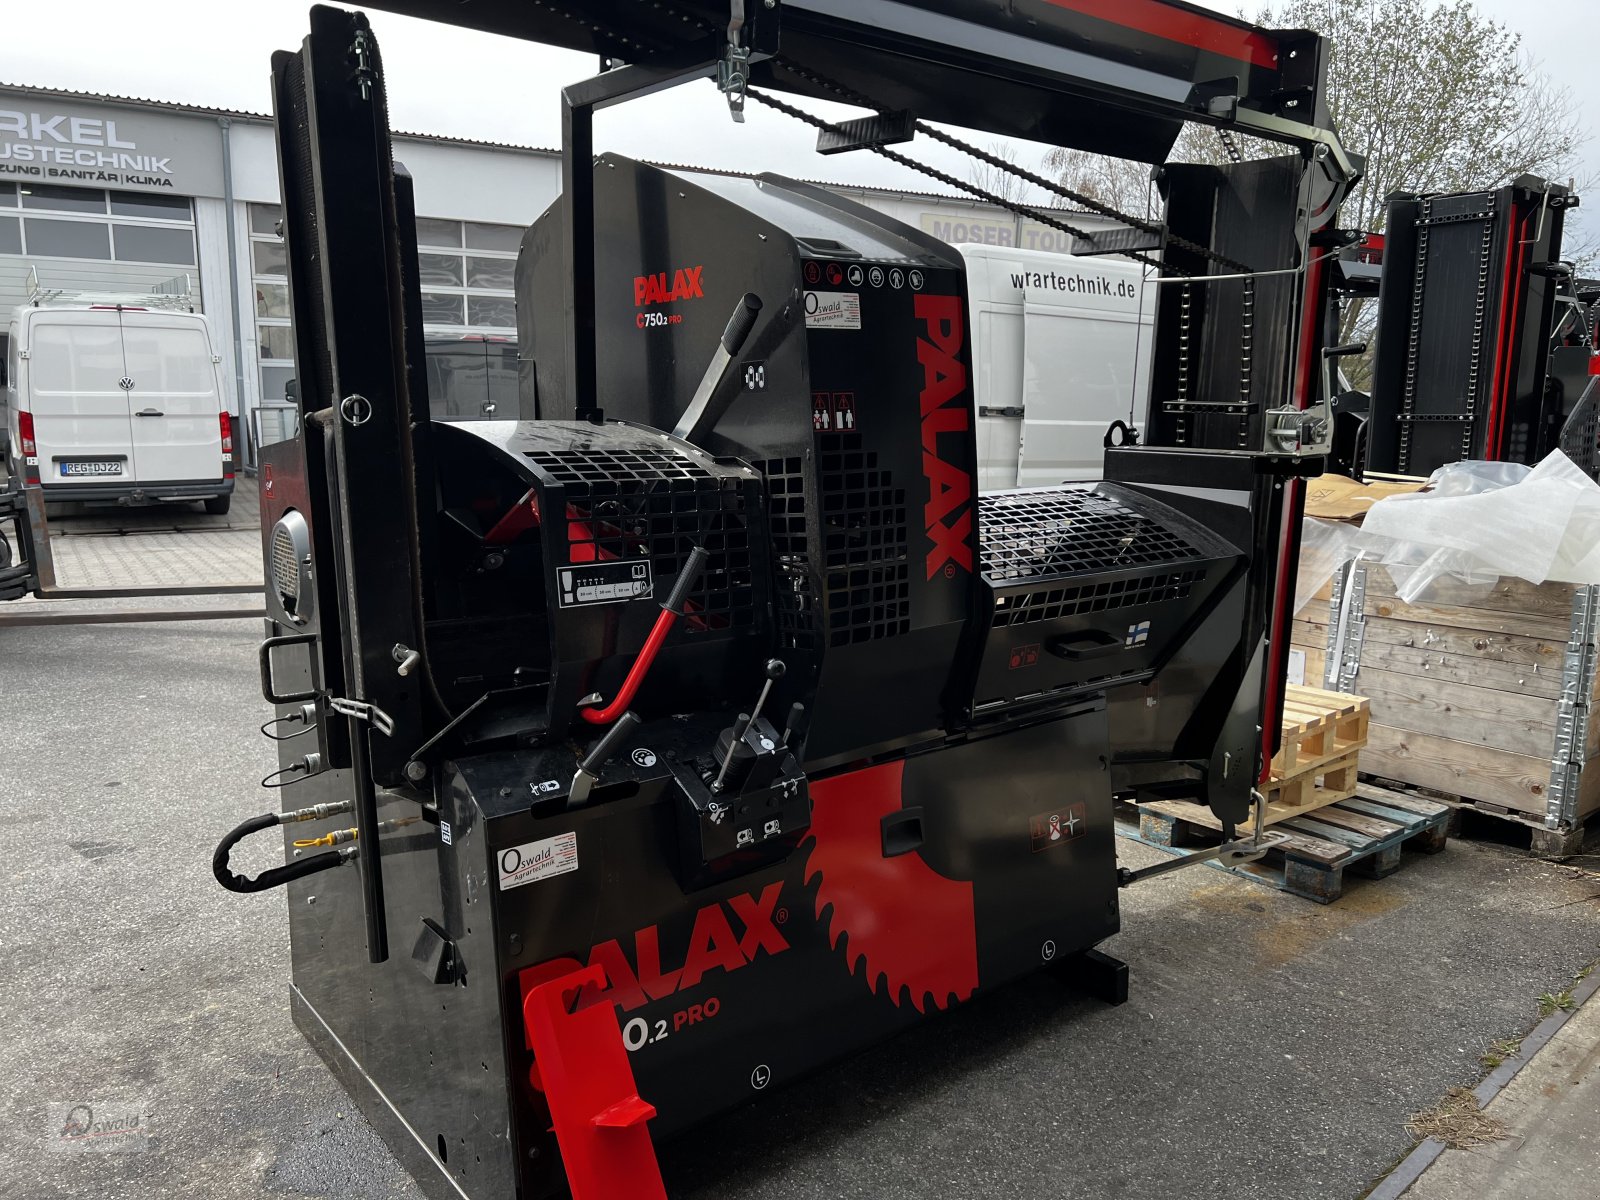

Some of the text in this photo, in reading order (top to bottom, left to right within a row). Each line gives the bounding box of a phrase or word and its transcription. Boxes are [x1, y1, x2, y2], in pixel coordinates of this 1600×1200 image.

[0, 110, 137, 150] RKEL
[48, 168, 119, 183] SANITÄR
[126, 175, 174, 187] KLIMA
[933, 221, 1012, 248] MOSER
[633, 265, 704, 306] PALAX
[804, 292, 841, 315] Oswald
[668, 314, 682, 325] PRO
[913, 293, 973, 582] PALAX
[67, 463, 88, 473] REG
[501, 847, 551, 874] Oswald
[514, 859, 555, 881] Agrartechnik
[622, 997, 721, 1052] 0.2 PRO
